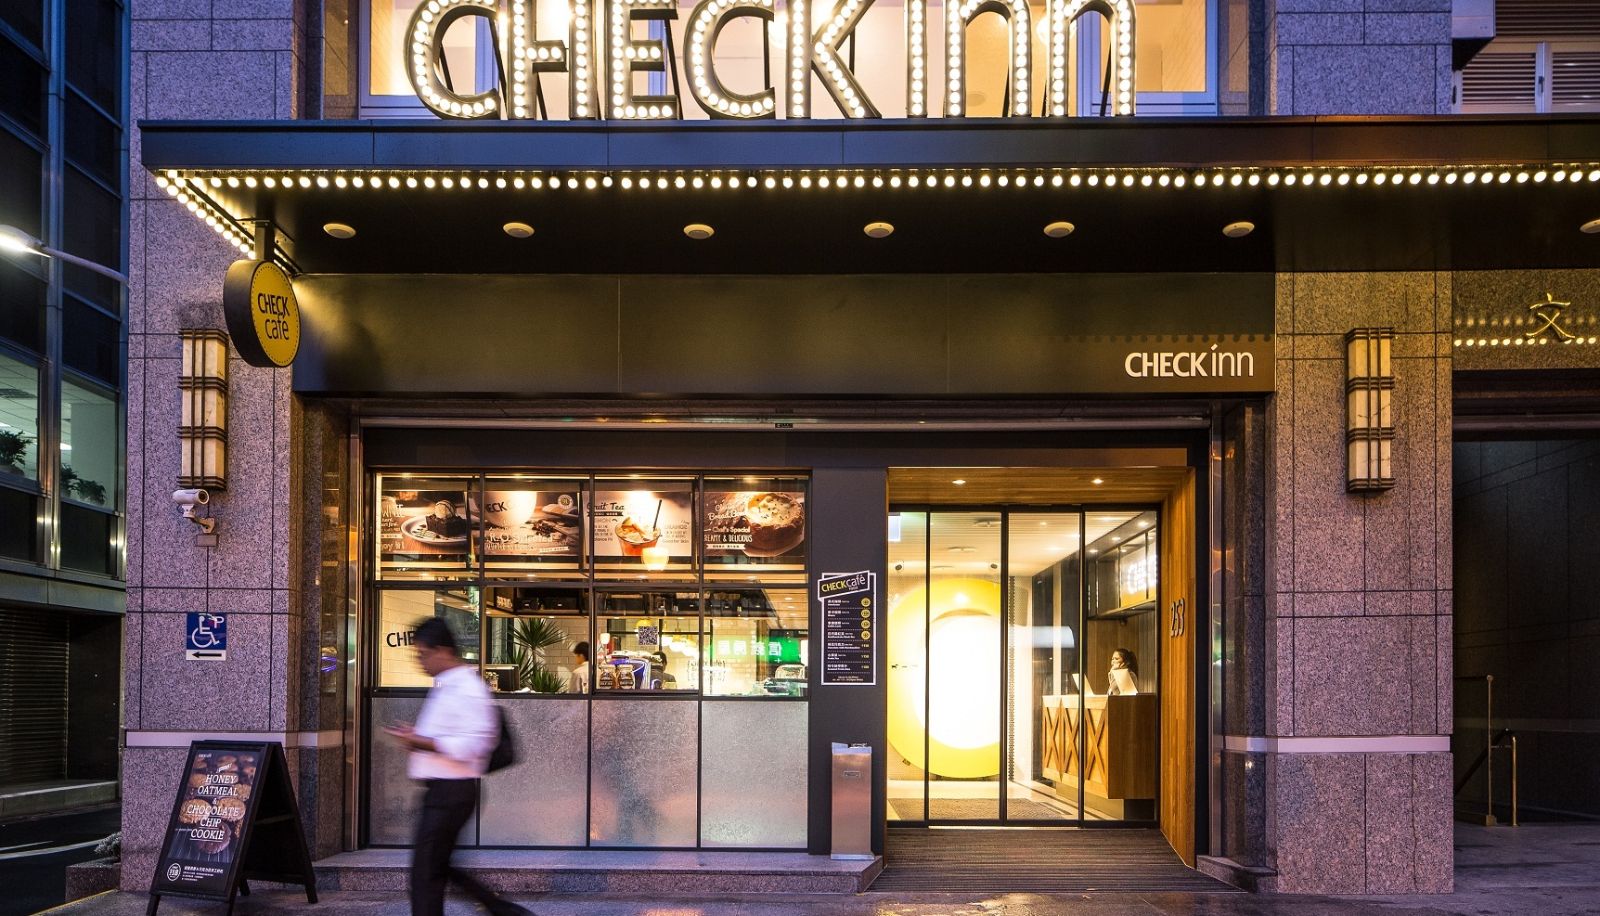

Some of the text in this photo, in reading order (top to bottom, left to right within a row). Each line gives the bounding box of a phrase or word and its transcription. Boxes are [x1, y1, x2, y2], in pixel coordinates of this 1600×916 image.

[257, 292, 290, 316] CHECK
[1526, 292, 1576, 339] 文
[610, 502, 625, 511] Tea
[730, 525, 751, 534] Special
[722, 534, 727, 542] &
[205, 774, 238, 785] HONEY
[197, 786, 238, 796] OATMEAL
[186, 806, 240, 817] CHOCOLATE
[200, 818, 222, 828] CHIP
[190, 829, 225, 840] COOKIE
